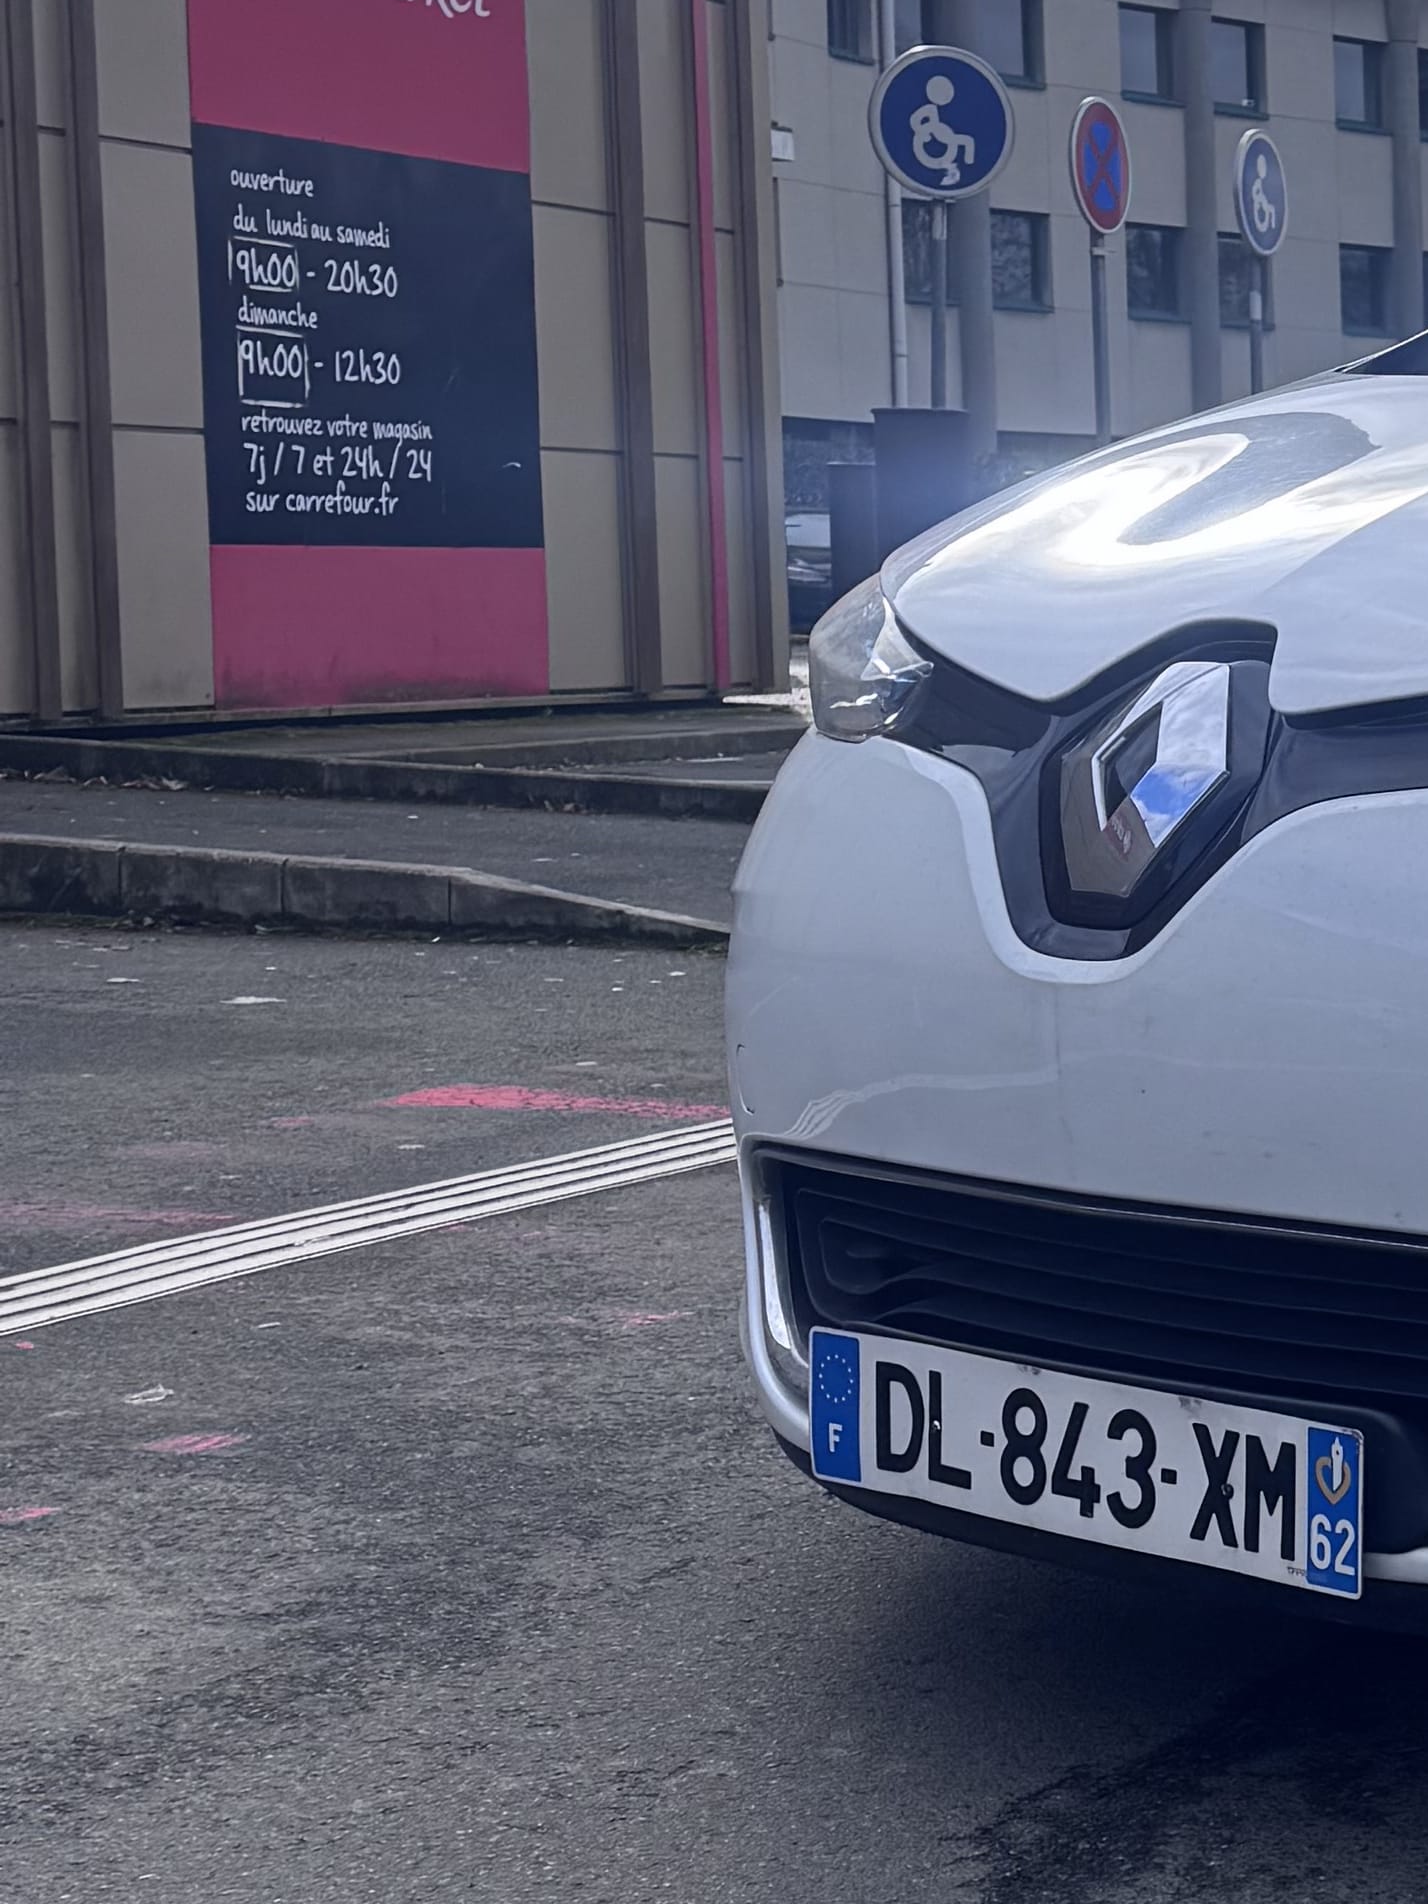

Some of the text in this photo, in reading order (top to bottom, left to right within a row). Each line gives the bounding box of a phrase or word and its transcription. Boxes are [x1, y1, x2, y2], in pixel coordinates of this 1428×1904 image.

[230, 168, 314, 197] ouverture
[233, 203, 390, 248] du lundi au samedi
[236, 247, 297, 288] 9h00
[324, 259, 398, 298] 20h30
[237, 294, 318, 329] dimanche
[239, 339, 302, 378] 9h00
[335, 348, 401, 385] 12h30
[241, 408, 433, 448] retrouvez votre magasin
[312, 446, 335, 477] et
[246, 479, 399, 516] sur carrefour.fr
[827, 1422, 843, 1454] F
[874, 1360, 1297, 1562] DL-843-XM
[1309, 1512, 1356, 1576] 62
